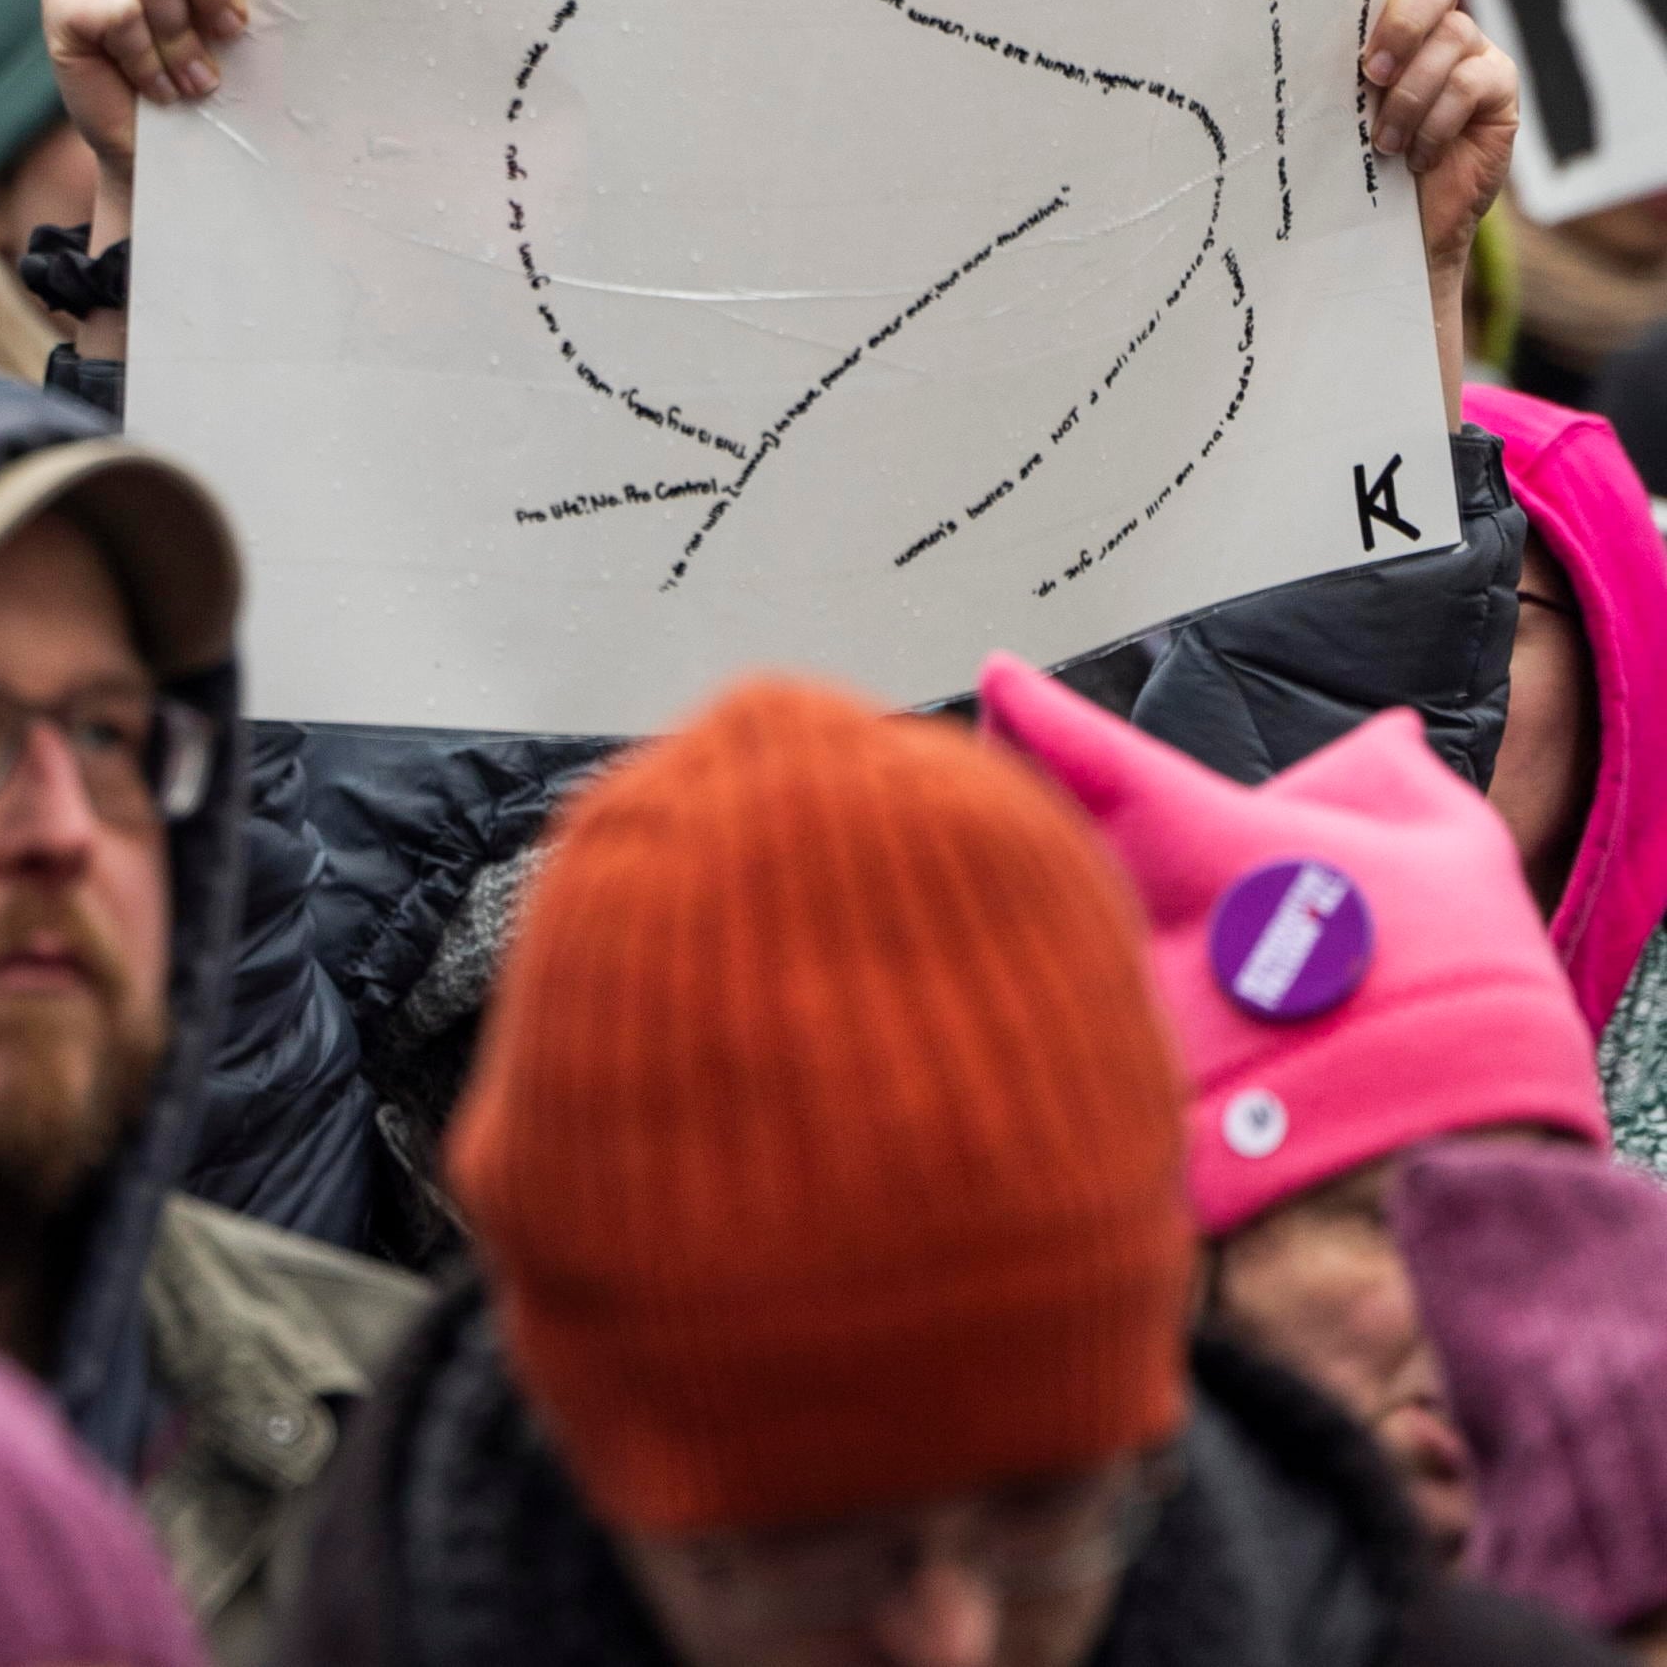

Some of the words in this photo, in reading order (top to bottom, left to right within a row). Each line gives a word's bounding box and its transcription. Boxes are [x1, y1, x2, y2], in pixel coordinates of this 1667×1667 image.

[973, 30, 1001, 52] we
[1002, 40, 1031, 66] are
[505, 144, 527, 181] you
[508, 199, 524, 233] for
[965, 479, 1015, 520] bodies
[1018, 451, 1044, 481] are
[1049, 405, 1083, 445] NOT
[1089, 388, 1100, 407] a
[1103, 308, 1161, 389] political
[516, 508, 548, 526] Pro
[623, 483, 653, 505] Pro
[1144, 485, 1172, 521] will
[1097, 518, 1140, 561] never
[1063, 548, 1093, 582] give
